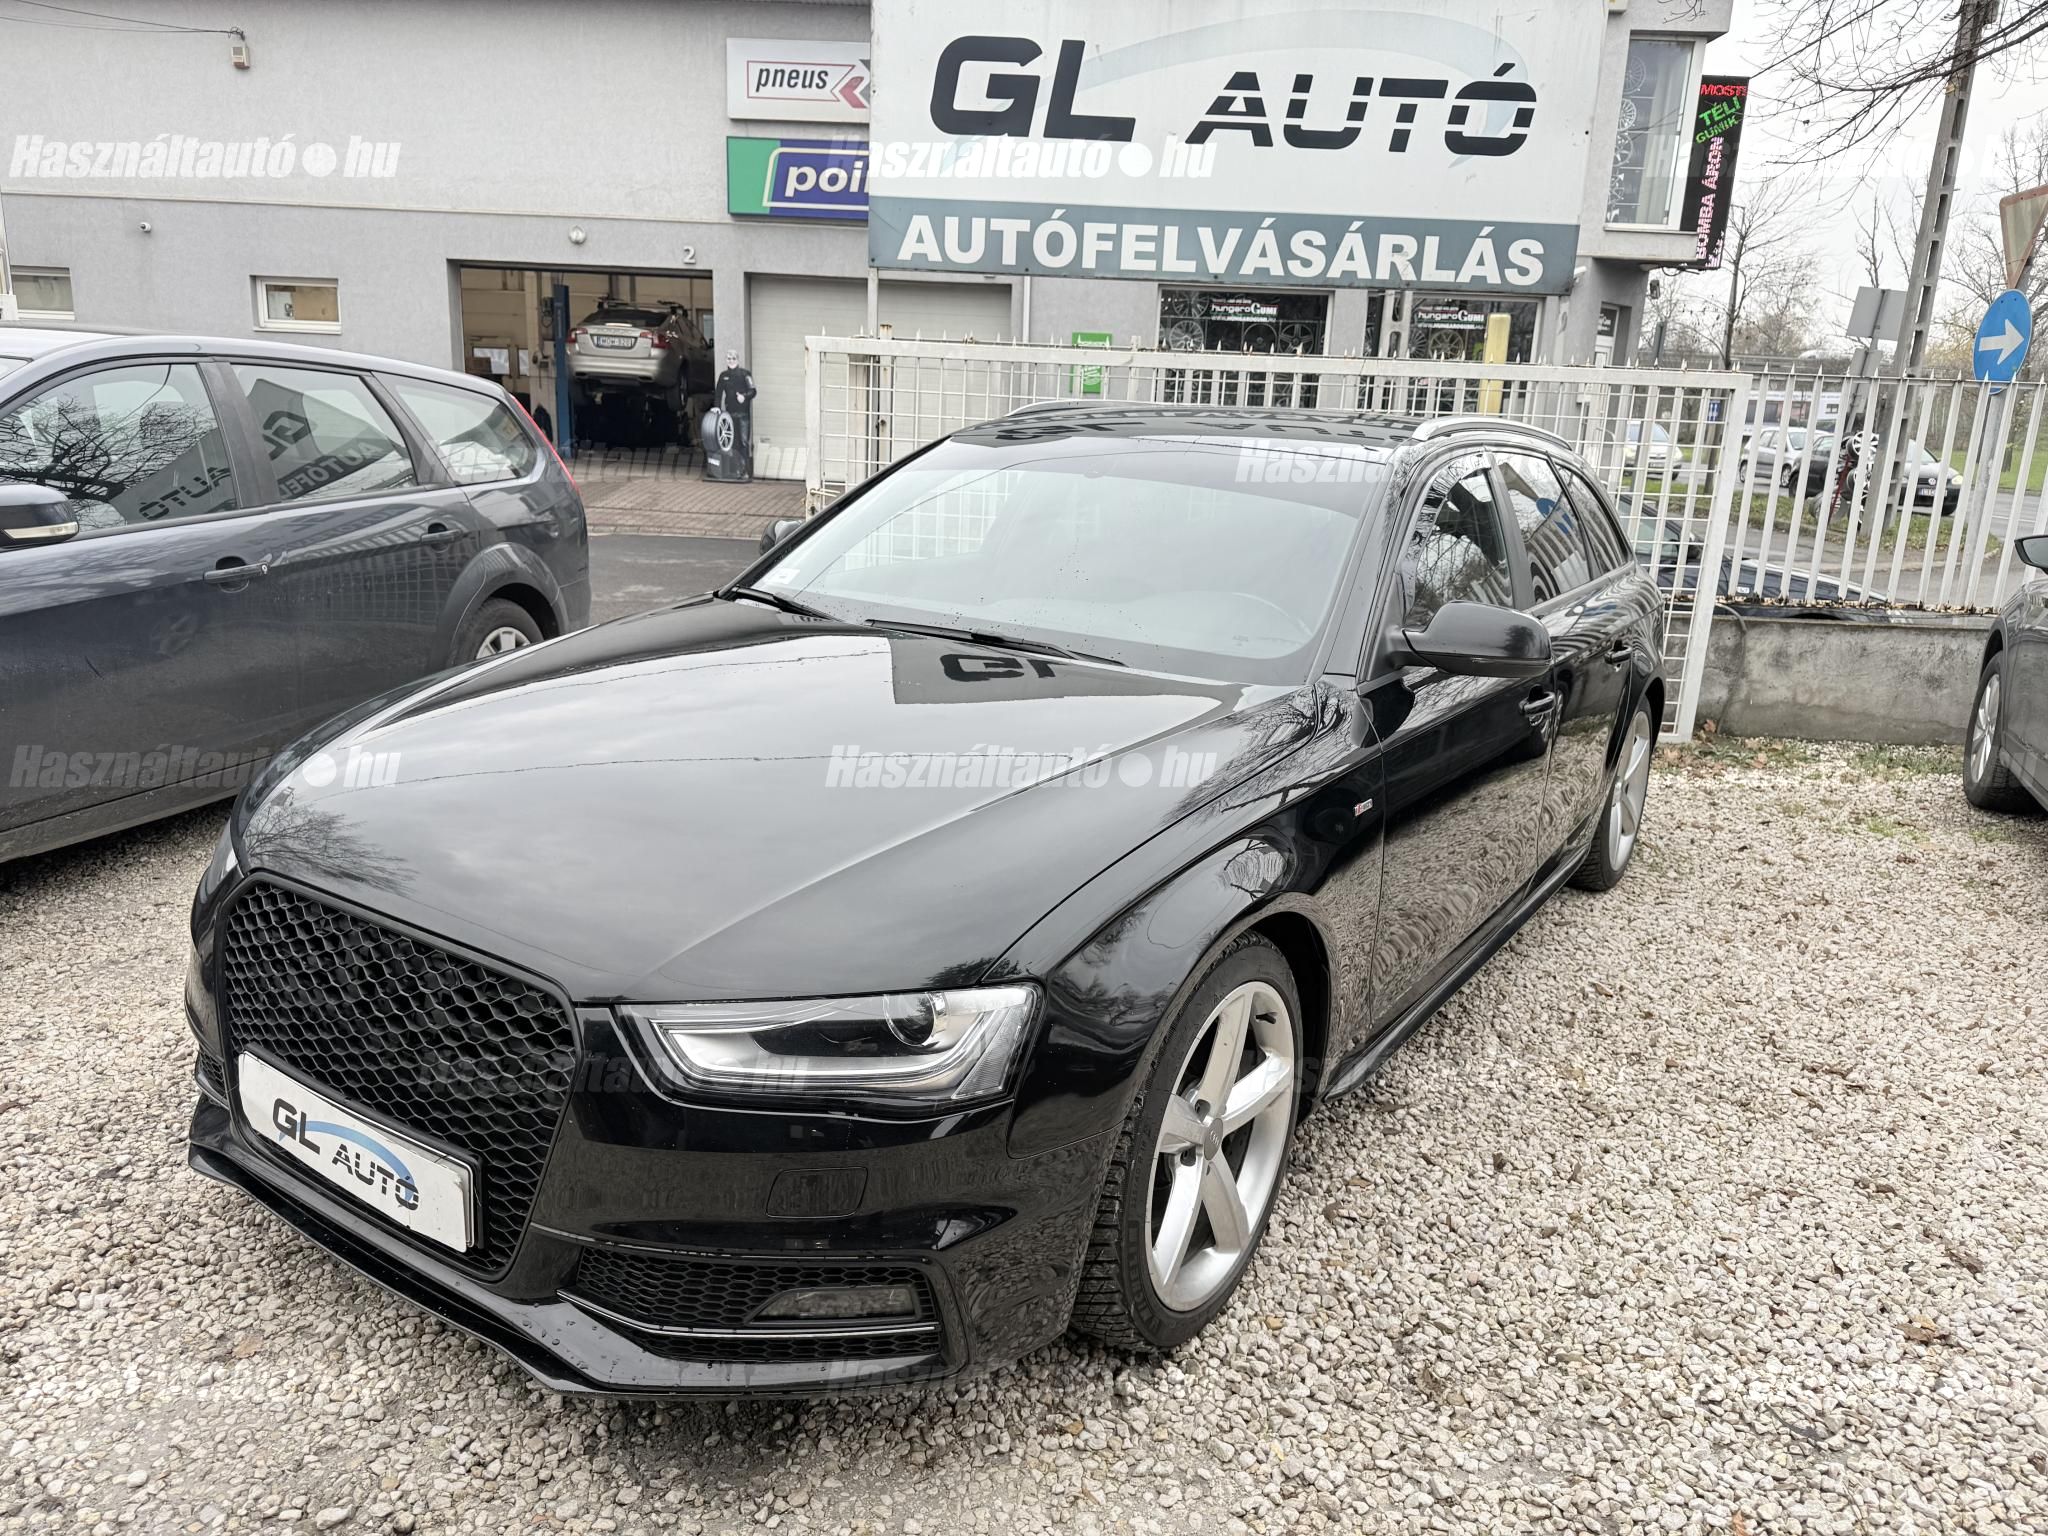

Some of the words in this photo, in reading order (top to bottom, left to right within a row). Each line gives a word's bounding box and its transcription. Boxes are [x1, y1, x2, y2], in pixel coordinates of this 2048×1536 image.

[755, 67, 829, 93] pneus
[930, 35, 1137, 142] GL
[1184, 62, 1538, 157] AUTÓ
[1698, 95, 1742, 127] TÉLI
[784, 160, 869, 198] poi
[683, 245, 696, 263] 2
[897, 207, 1545, 286] AUTÓFELVÁSÁRLÁS
[272, 1097, 321, 1156] GL
